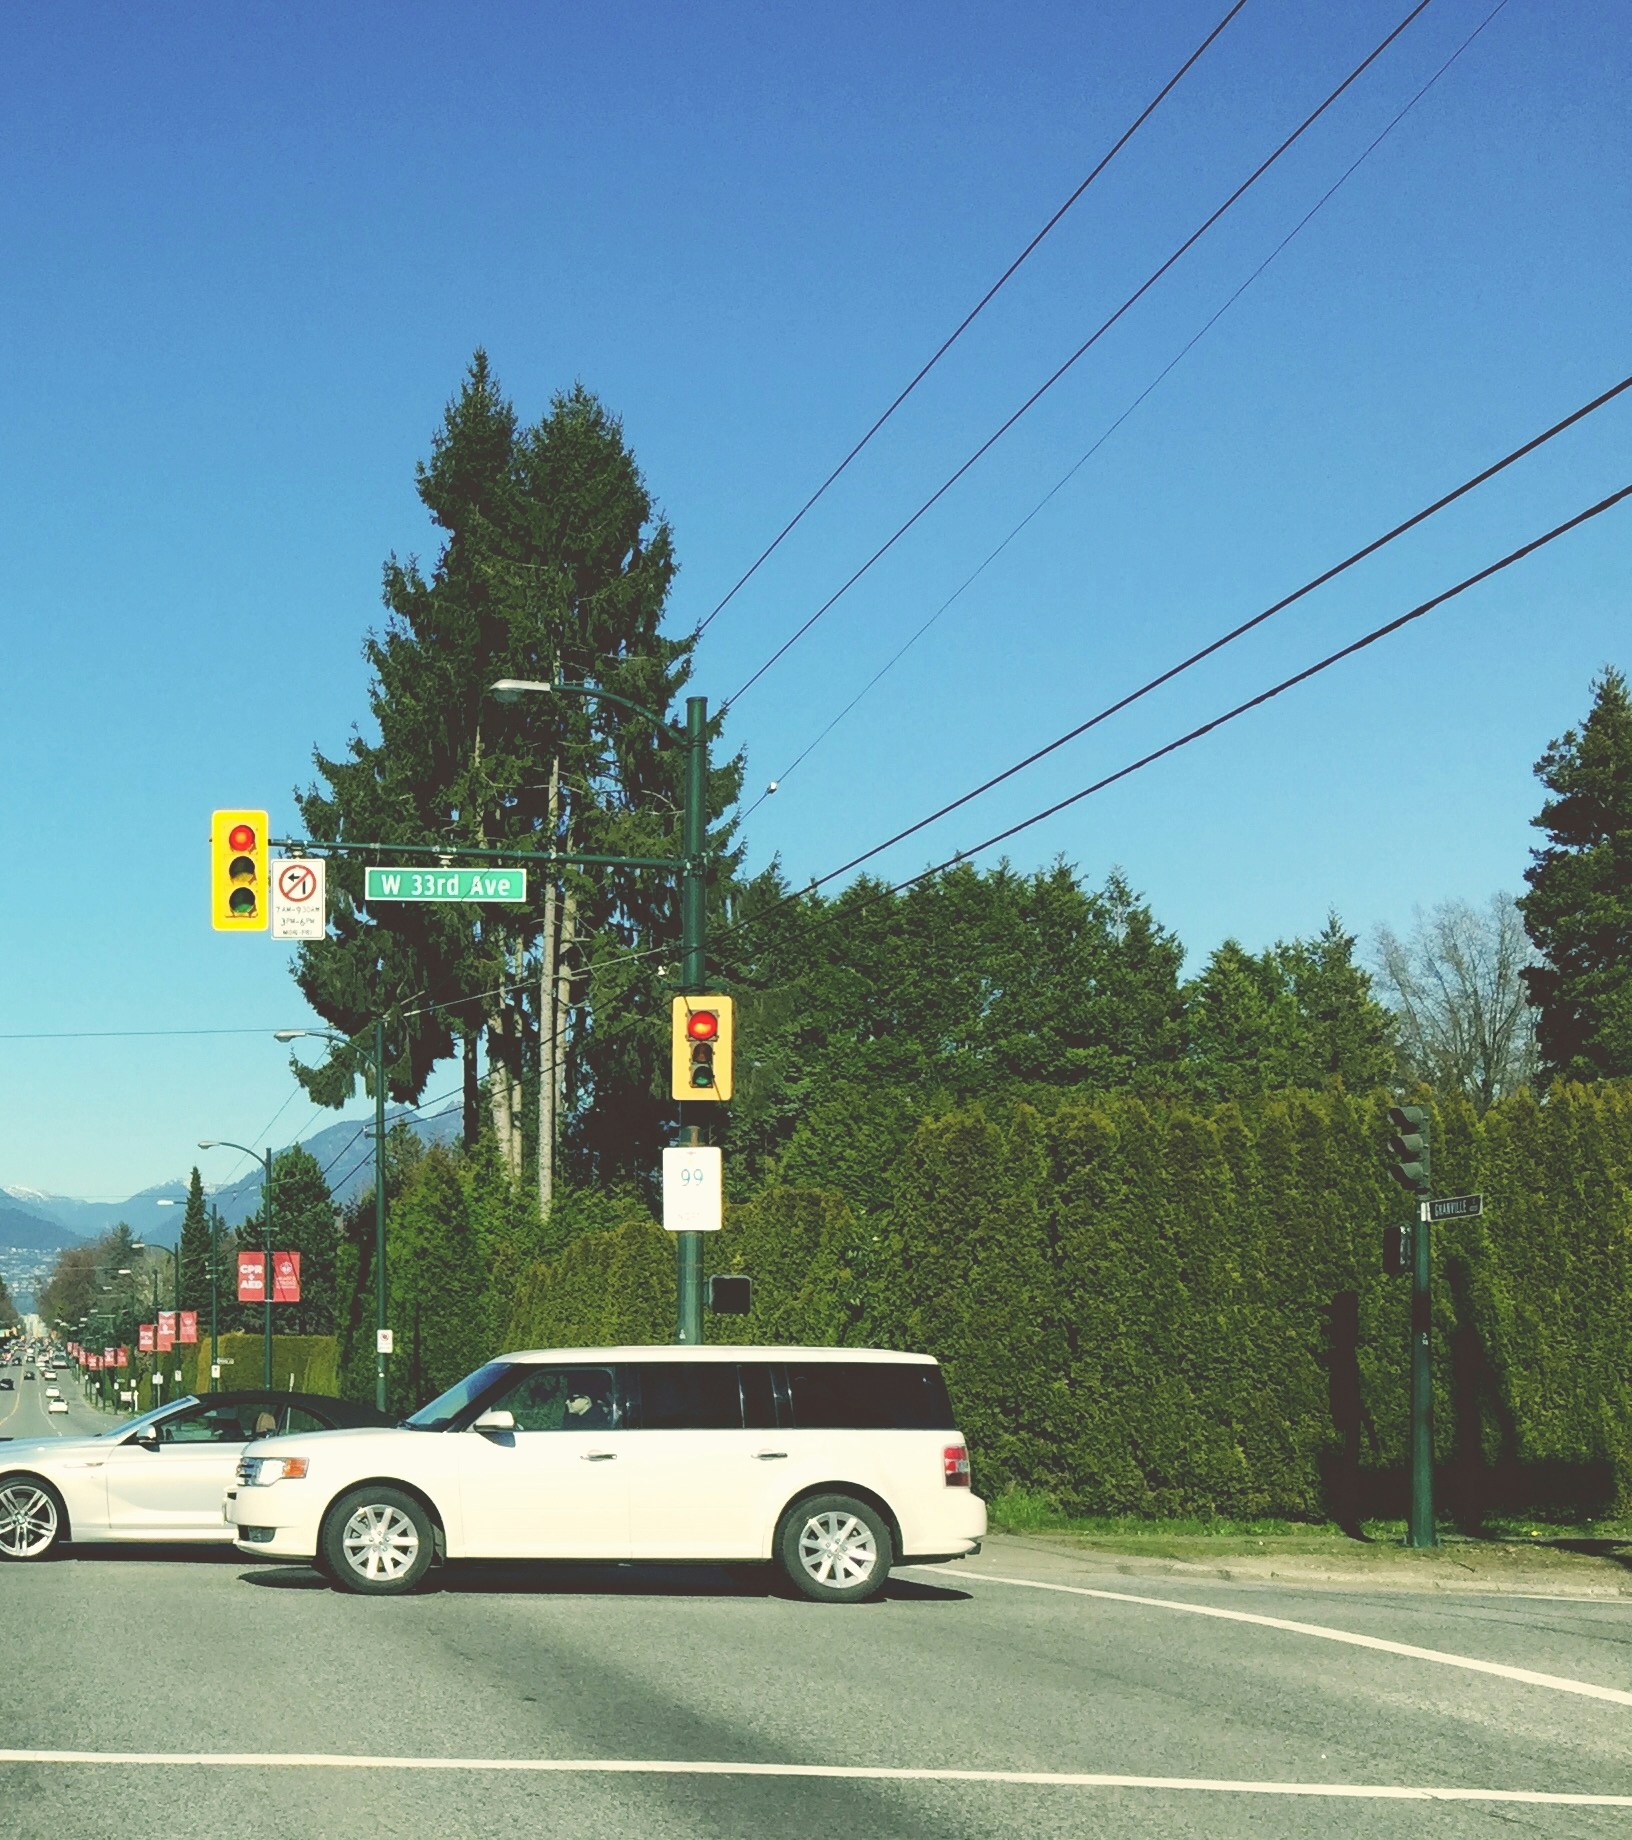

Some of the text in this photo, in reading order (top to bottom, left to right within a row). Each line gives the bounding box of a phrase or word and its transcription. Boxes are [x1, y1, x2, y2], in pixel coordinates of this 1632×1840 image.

[381, 874, 511, 896] W 33rd Ave
[681, 1168, 703, 1187] 99
[239, 1263, 264, 1275] CPR
[240, 1279, 264, 1289] AED
